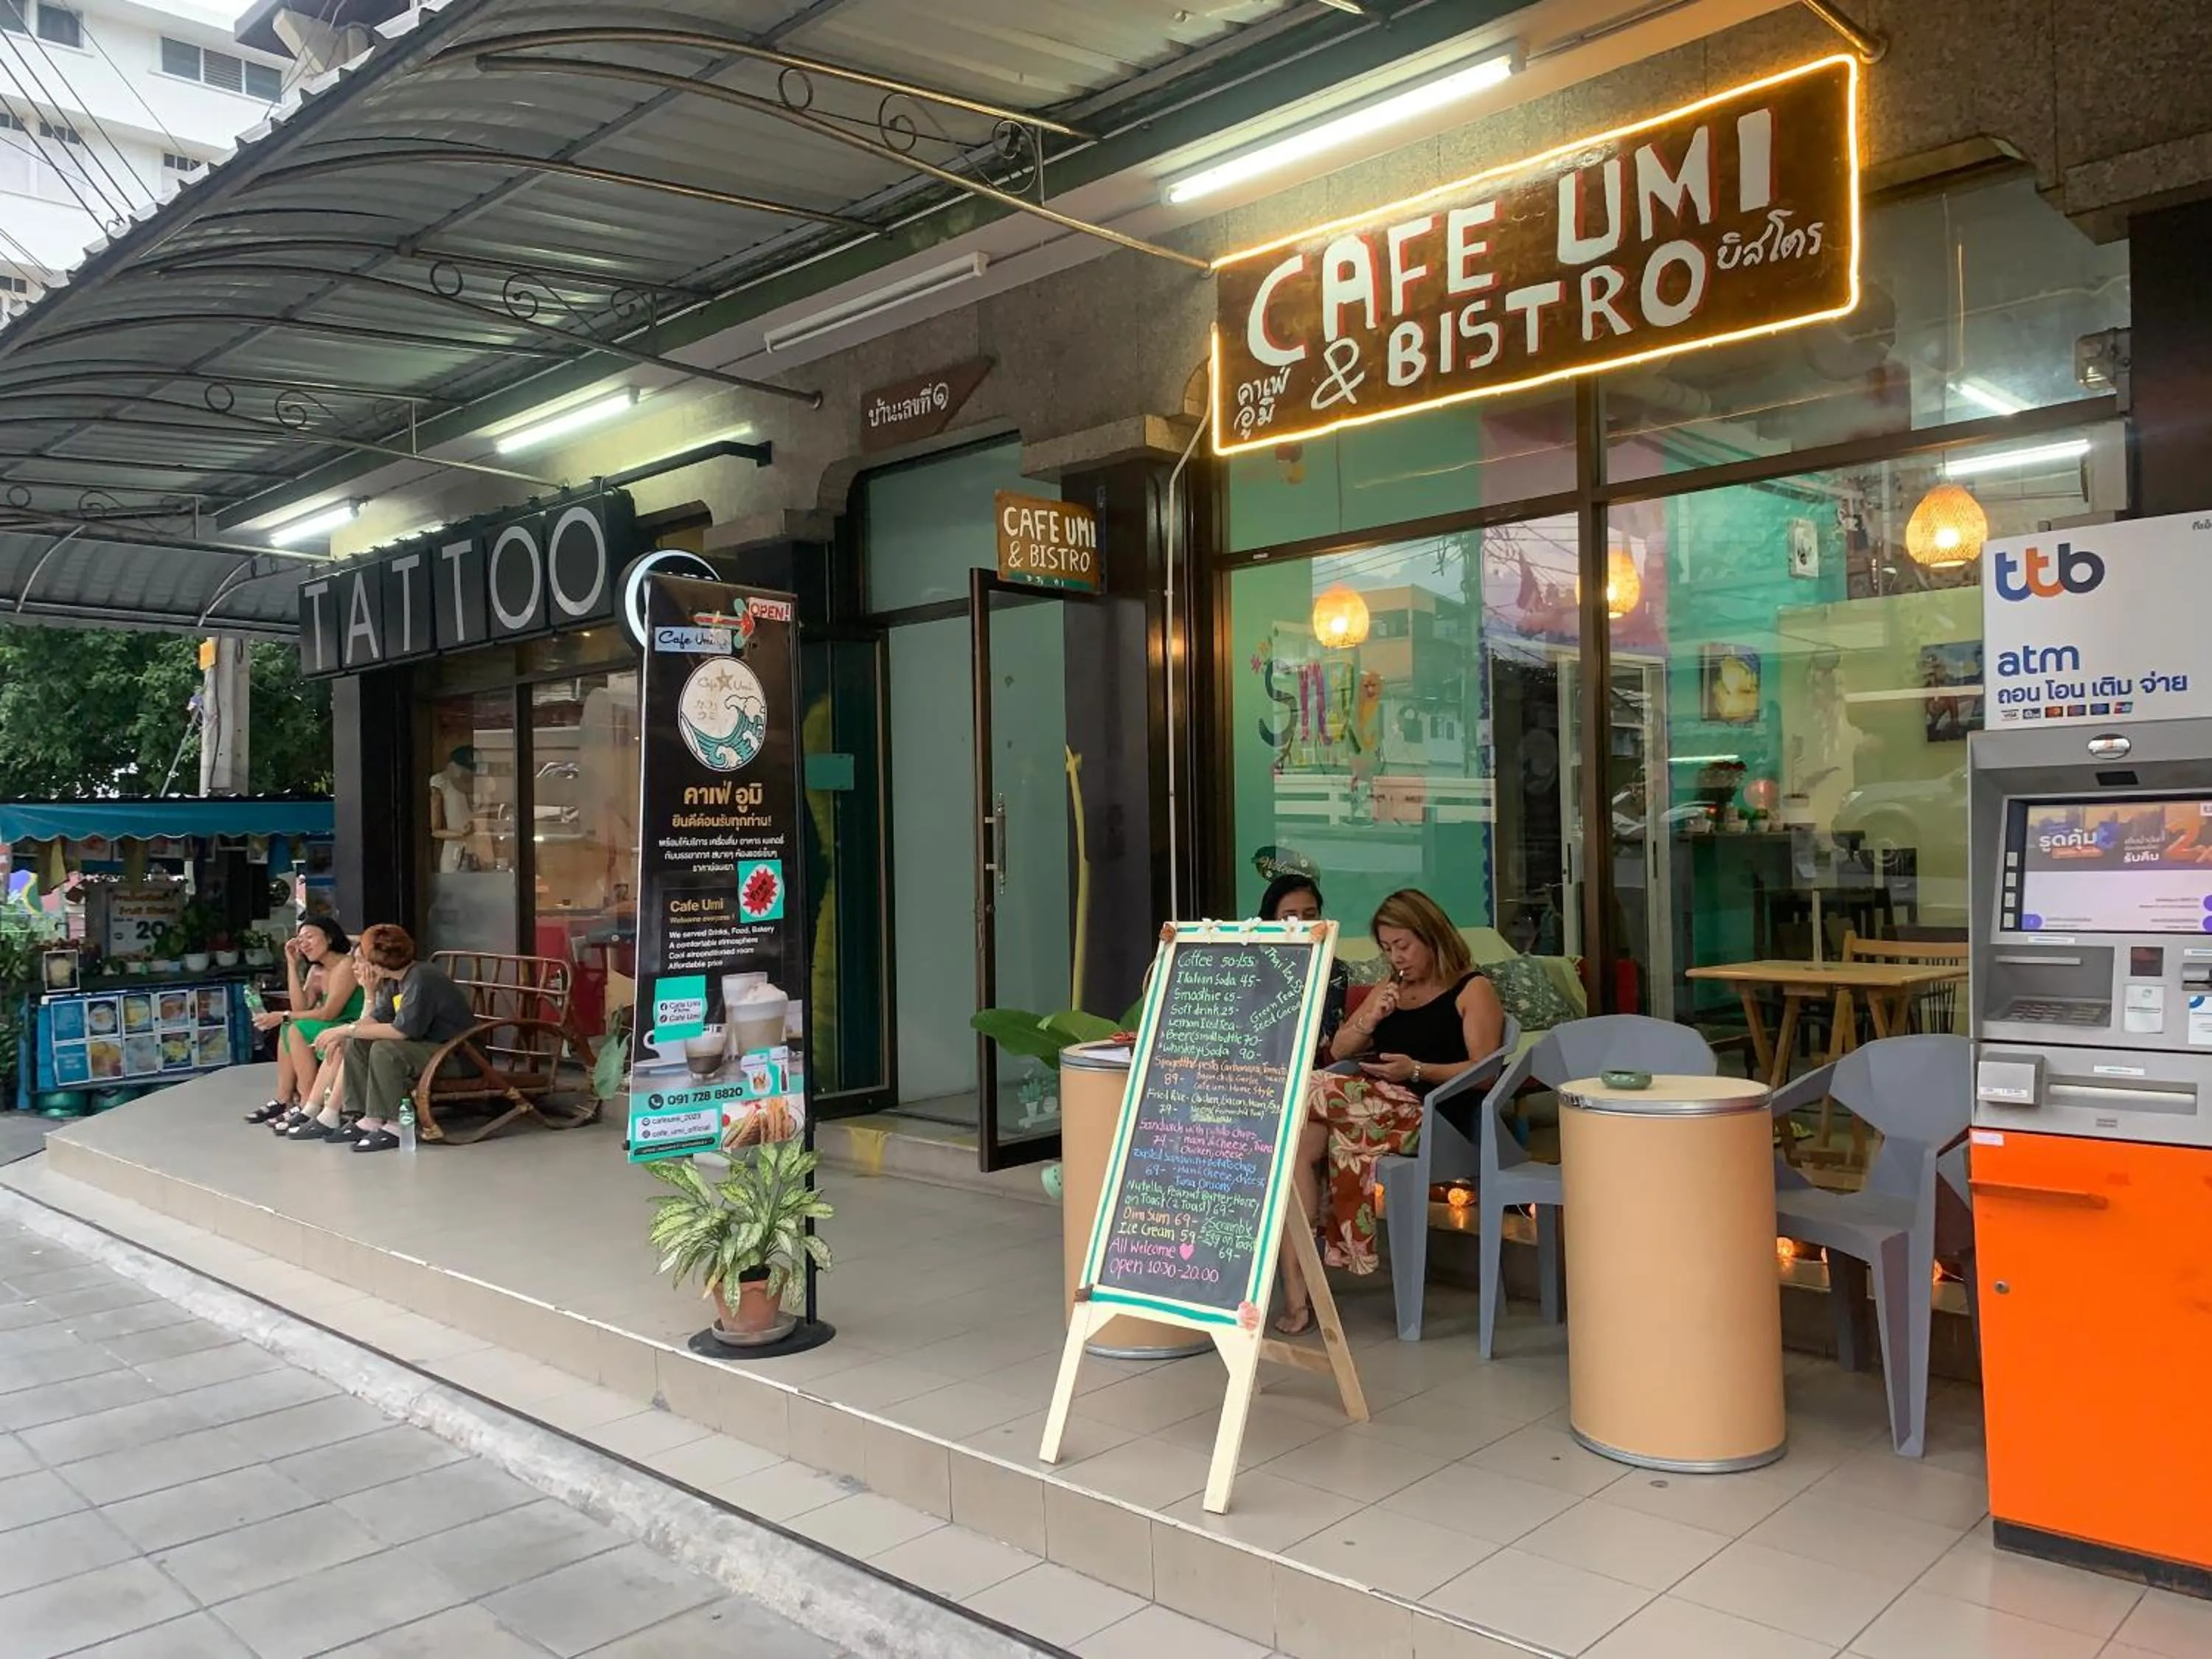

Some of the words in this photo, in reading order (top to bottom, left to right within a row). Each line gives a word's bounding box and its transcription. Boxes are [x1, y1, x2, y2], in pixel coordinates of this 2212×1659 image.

[1247, 201, 1498, 366] CAFE
[1558, 108, 1771, 265] UMI
[1716, 209, 1825, 270] บิสโตร
[1310, 337, 1365, 411] &
[1387, 240, 1705, 388] BISTRO
[1004, 507, 1060, 543] CAFE
[1065, 516, 1096, 548] UMI
[1008, 540, 1023, 568] &
[1030, 543, 1091, 572] BISTRO
[1994, 543, 2105, 602] ttb
[305, 507, 607, 670] TATTOO
[751, 602, 790, 621] OPEN!
[658, 630, 692, 650] Cafe
[695, 632, 714, 646] Umi
[1997, 645, 2080, 677] atm
[1997, 686, 2040, 704] ถอน
[2045, 679, 2085, 699] โอน
[2092, 675, 2132, 697] เติม
[2139, 670, 2188, 695] จ่าย
[684, 780, 732, 805] คาเฟ่
[736, 782, 762, 813] อูมิ
[2039, 828, 2098, 854] รูดคุ้ม
[670, 900, 699, 913] Cafe
[701, 898, 723, 911] Umi
[683, 930, 707, 939] served
[1178, 950, 1213, 967] Coffee
[1265, 946, 1282, 969] Thai
[1282, 961, 1297, 984] Tea
[1214, 971, 1237, 986] Soda
[1174, 987, 1221, 1001] Smoothie
[1250, 1002, 1278, 1023] Green
[1276, 991, 1295, 1004] Tea
[667, 1095, 689, 1105] 091
[692, 1091, 712, 1101] 728
[714, 1088, 743, 1099] 8820
[1124, 1195, 1139, 1206] on
[1123, 1206, 1145, 1220] Dim
[1147, 1209, 1169, 1225] Sum
[1117, 1222, 1137, 1234] Ice
[1141, 1223, 1175, 1241] Cream
[1108, 1237, 1127, 1253] All
[1130, 1239, 1176, 1259] Welcome
